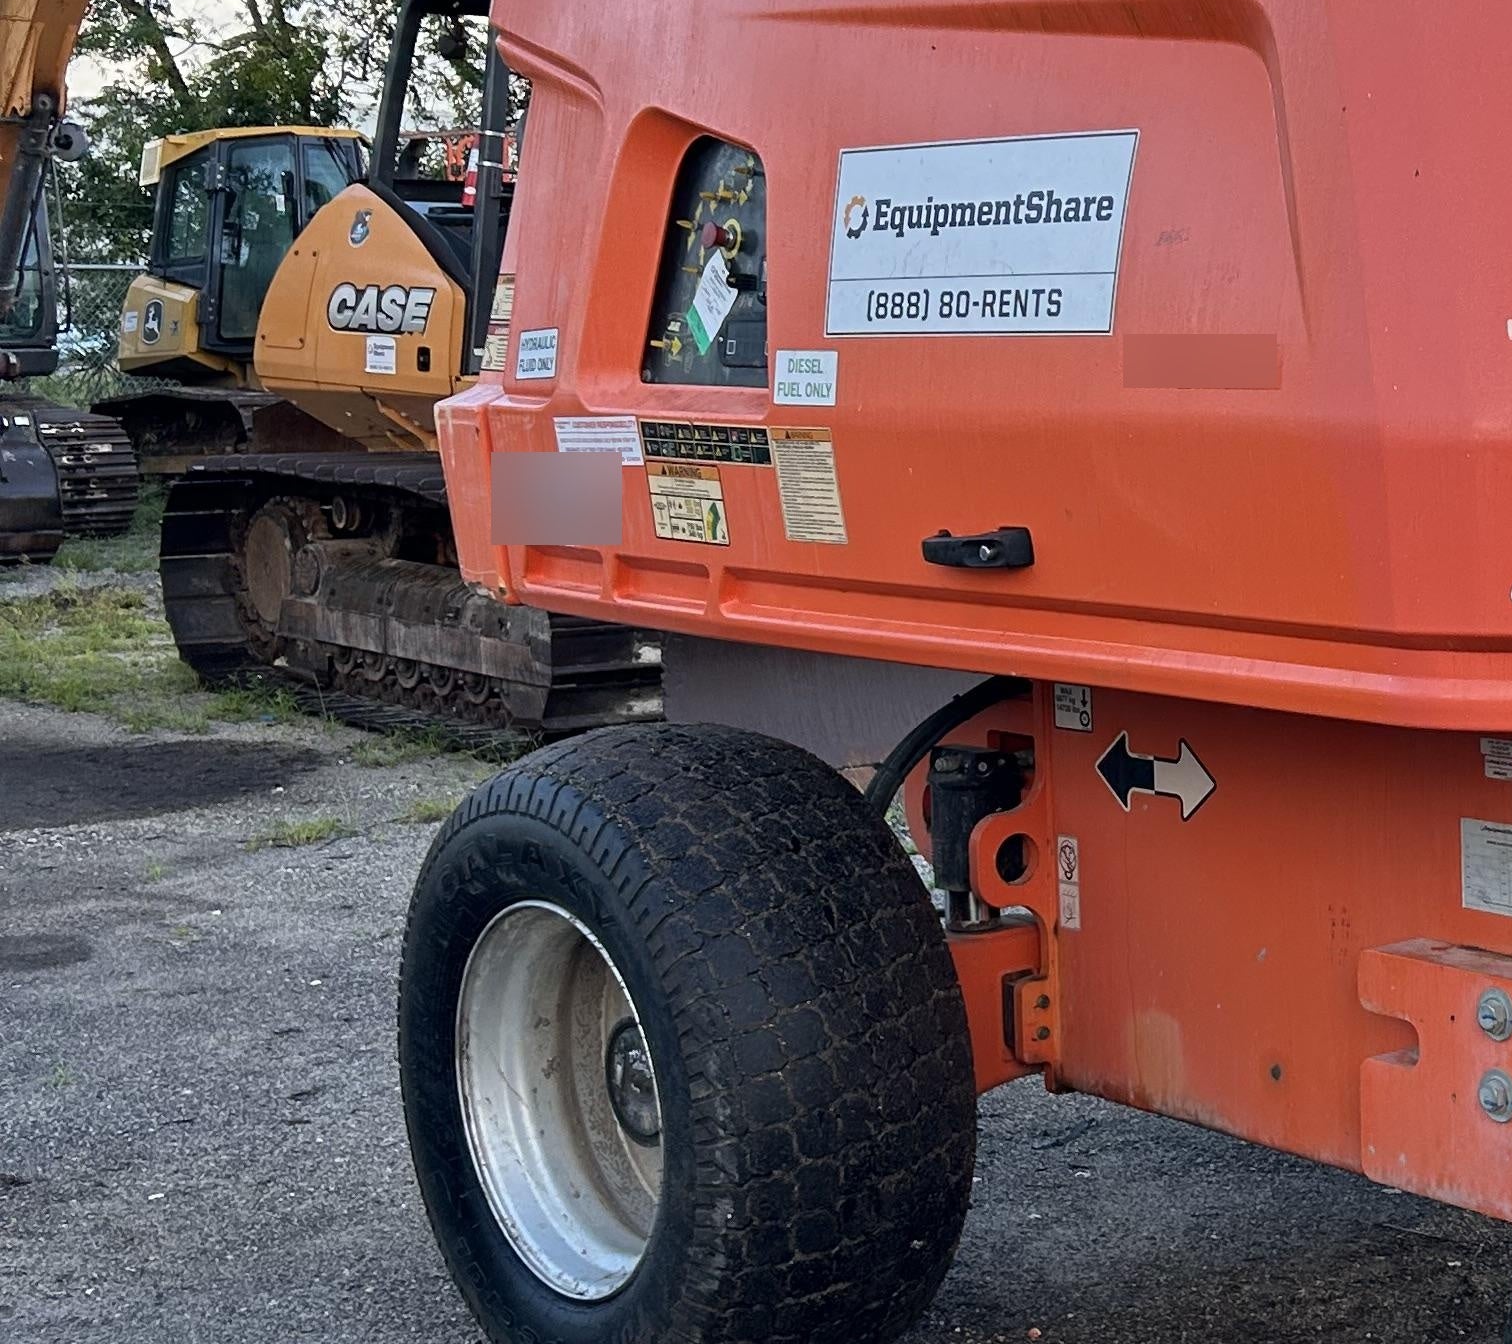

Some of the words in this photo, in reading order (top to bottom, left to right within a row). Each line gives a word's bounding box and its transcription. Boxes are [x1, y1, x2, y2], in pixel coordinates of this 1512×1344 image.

[872, 190, 1114, 238] EquipmentShare
[327, 282, 437, 334] CASE
[867, 289, 931, 321] (888)
[939, 288, 1063, 318] 80-RENTS
[537, 357, 555, 371] ONLY
[787, 358, 823, 374] DIESEL
[777, 381, 802, 398] FUEL
[805, 382, 832, 398] ONLY
